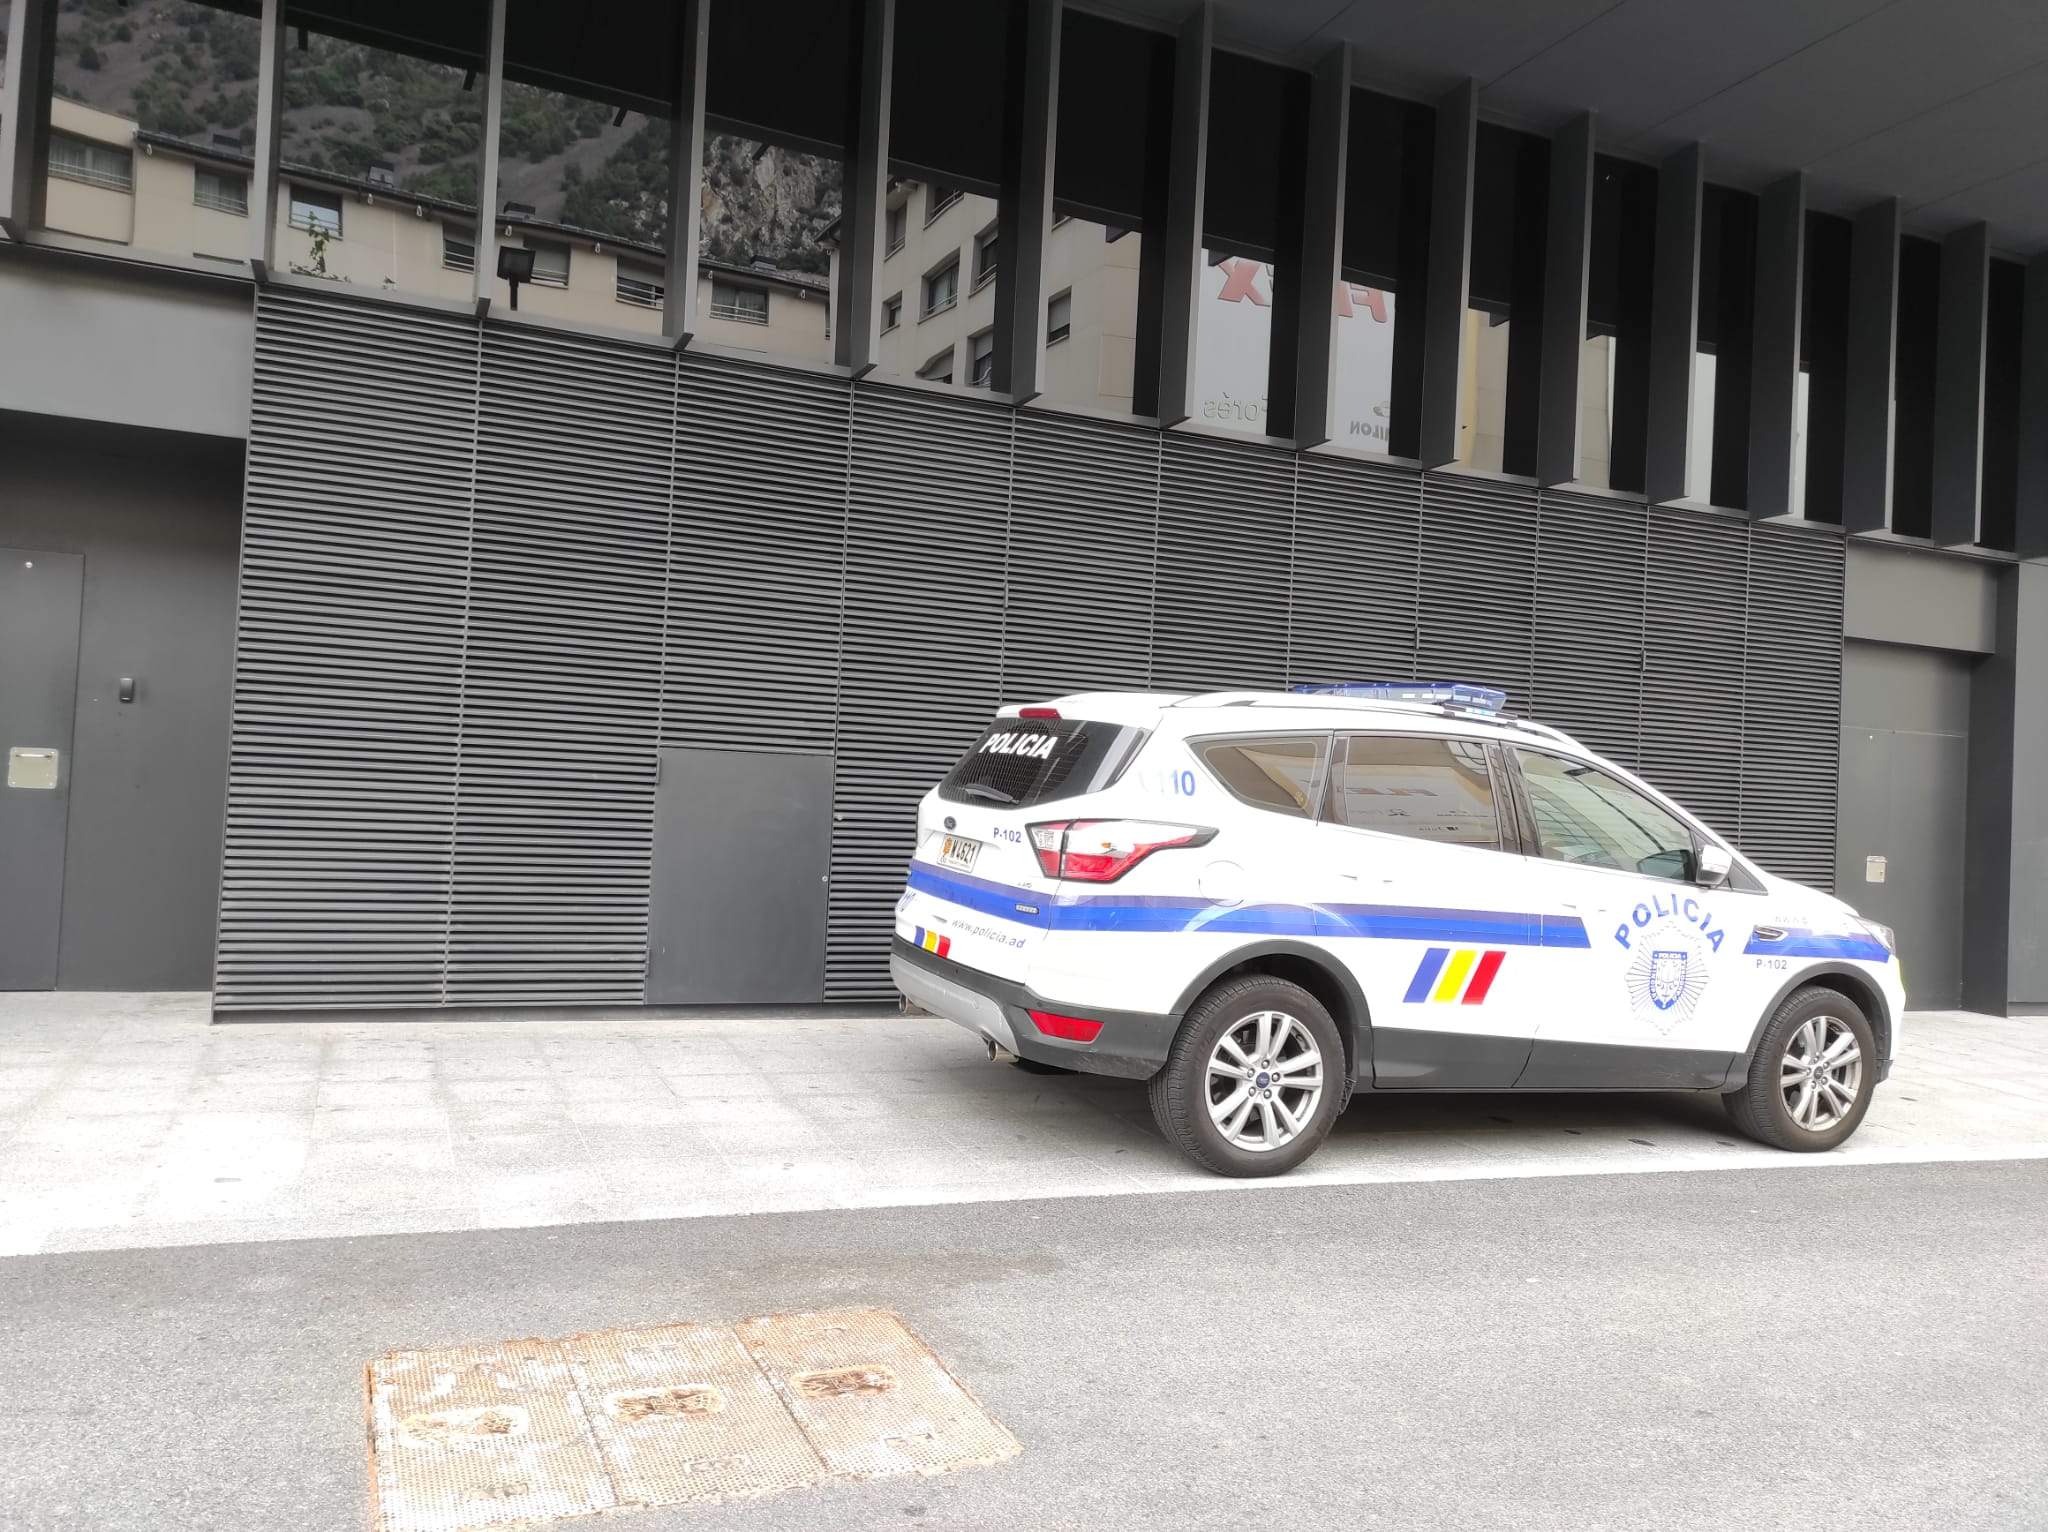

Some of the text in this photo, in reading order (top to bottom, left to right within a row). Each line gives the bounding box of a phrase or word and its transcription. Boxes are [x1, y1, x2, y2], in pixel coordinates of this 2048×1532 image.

[978, 733, 1058, 759] POLICIA
[993, 827, 1022, 843] P-102
[952, 919, 1026, 949] www.policia.ad
[1614, 893, 1725, 953] POLICIA
[1756, 958, 1787, 970] P-102
